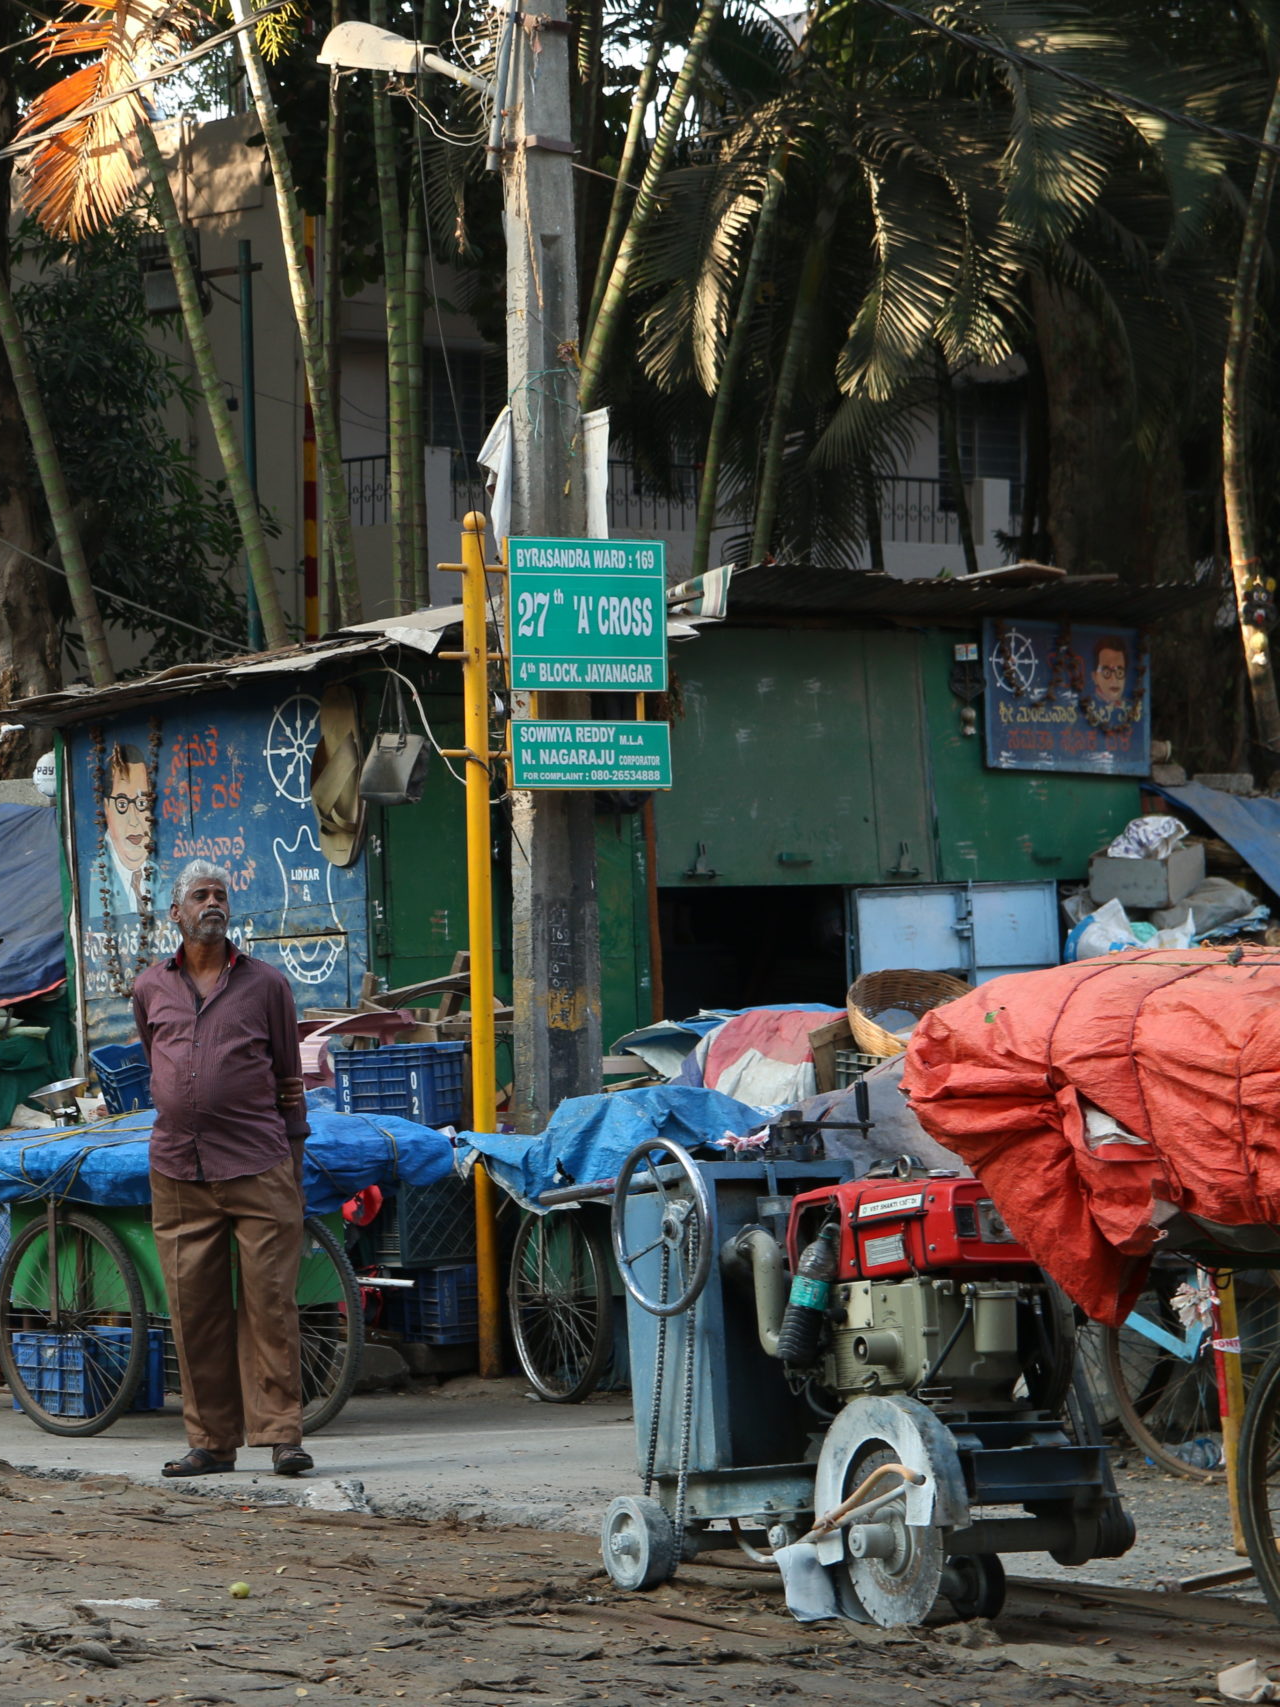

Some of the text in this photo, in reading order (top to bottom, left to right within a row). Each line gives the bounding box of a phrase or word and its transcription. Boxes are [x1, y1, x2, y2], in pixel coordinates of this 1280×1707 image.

[516, 548, 591, 568] BYRASANDRA
[593, 550, 626, 569] WARD
[635, 551, 654, 570] 169
[597, 596, 653, 637] CROSS
[520, 662, 536, 682] 4th
[584, 663, 653, 683] JAYANAGAR
[520, 726, 572, 743] SOWMYA
[575, 727, 616, 743] REDDY
[522, 749, 660, 766] N. NAGARAJU CORPORATOR
[523, 771, 539, 780] FOR
[539, 772, 584, 781] COMPLAINT
[591, 770, 661, 781] 080-26534888
[290, 868, 320, 881] LIDKAR
